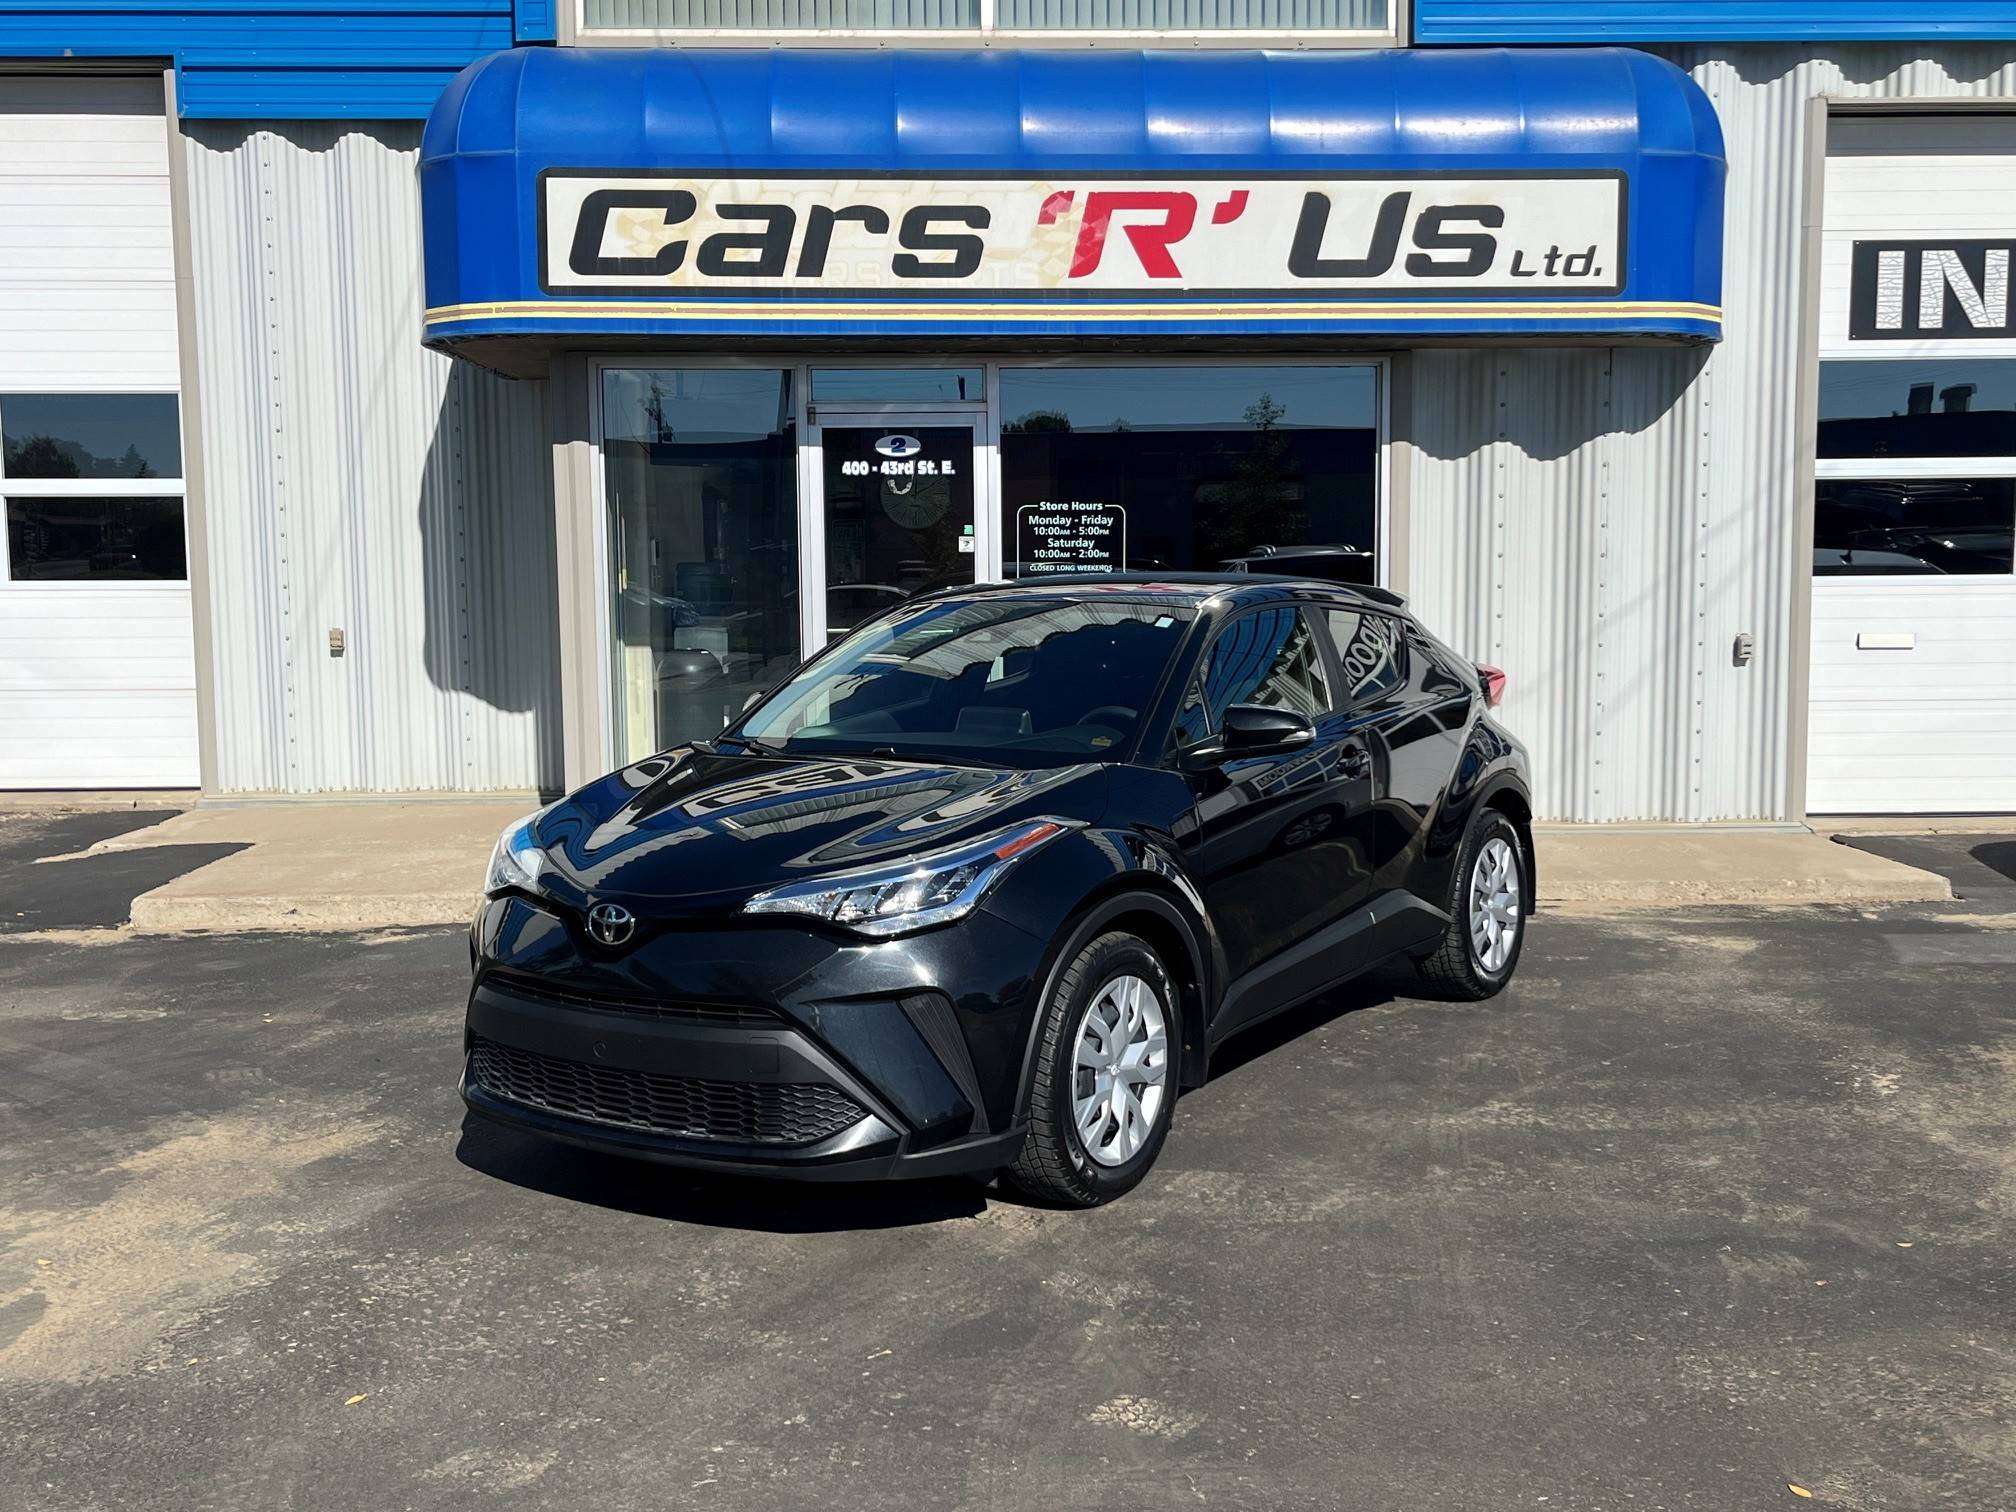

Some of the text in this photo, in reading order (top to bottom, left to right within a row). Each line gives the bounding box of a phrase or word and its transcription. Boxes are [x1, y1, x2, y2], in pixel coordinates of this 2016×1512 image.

[568, 188, 991, 279] Cars
[1287, 191, 1506, 278] Us
[1509, 244, 1603, 277] Ltd.
[890, 436, 907, 453] 2
[841, 460, 870, 475] 400
[880, 460, 914, 475] 43rd
[917, 460, 939, 475] St.
[941, 460, 956, 475] E.
[1039, 501, 1104, 511] Store Hours
[1028, 514, 1072, 526] Monday
[1081, 514, 1114, 527] Friday
[1047, 538, 1095, 549] Saturday
[1029, 564, 1113, 572] CLOSED LONG WEEKENDS
